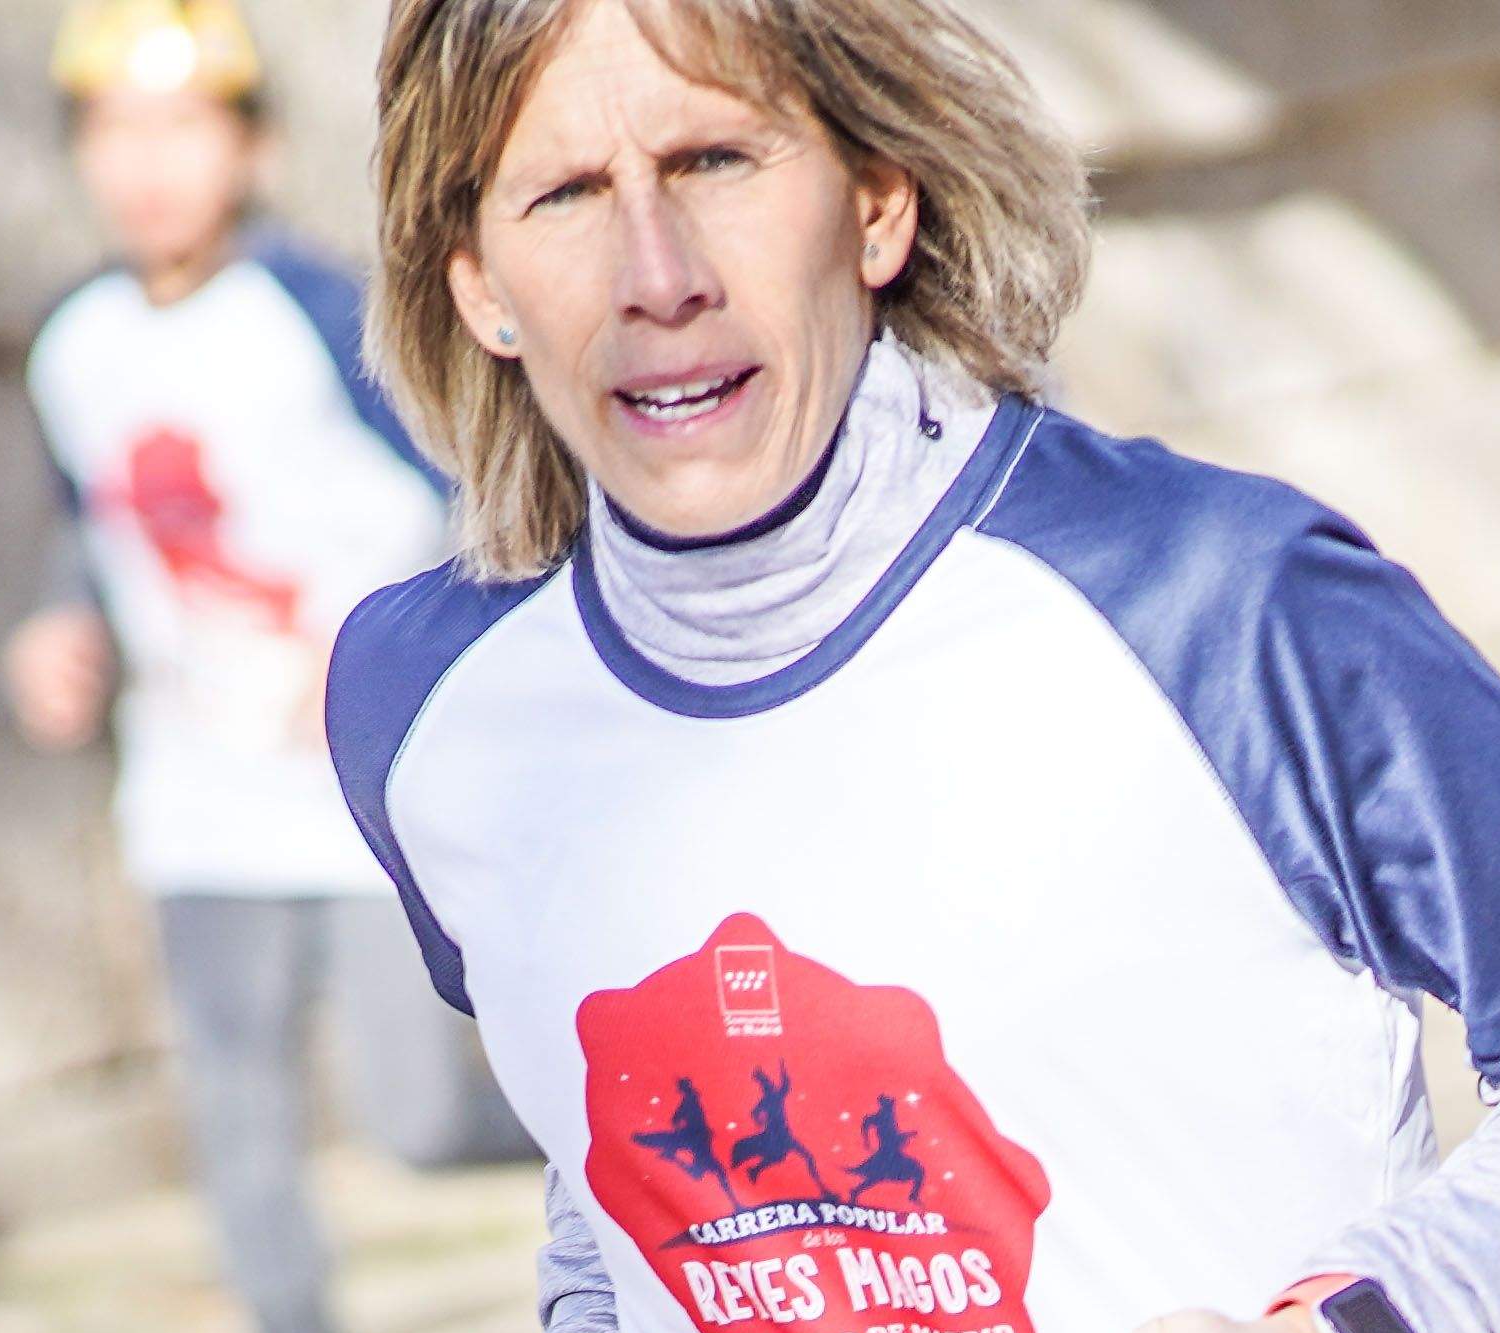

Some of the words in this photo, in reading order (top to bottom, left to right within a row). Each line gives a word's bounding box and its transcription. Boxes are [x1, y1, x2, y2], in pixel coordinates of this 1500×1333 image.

[688, 1202, 819, 1244] CARRERA
[819, 1202, 947, 1235] POPULAR
[802, 1229, 821, 1249] de
[681, 1253, 825, 1325] REYES
[836, 1247, 1001, 1315] MAGOS
